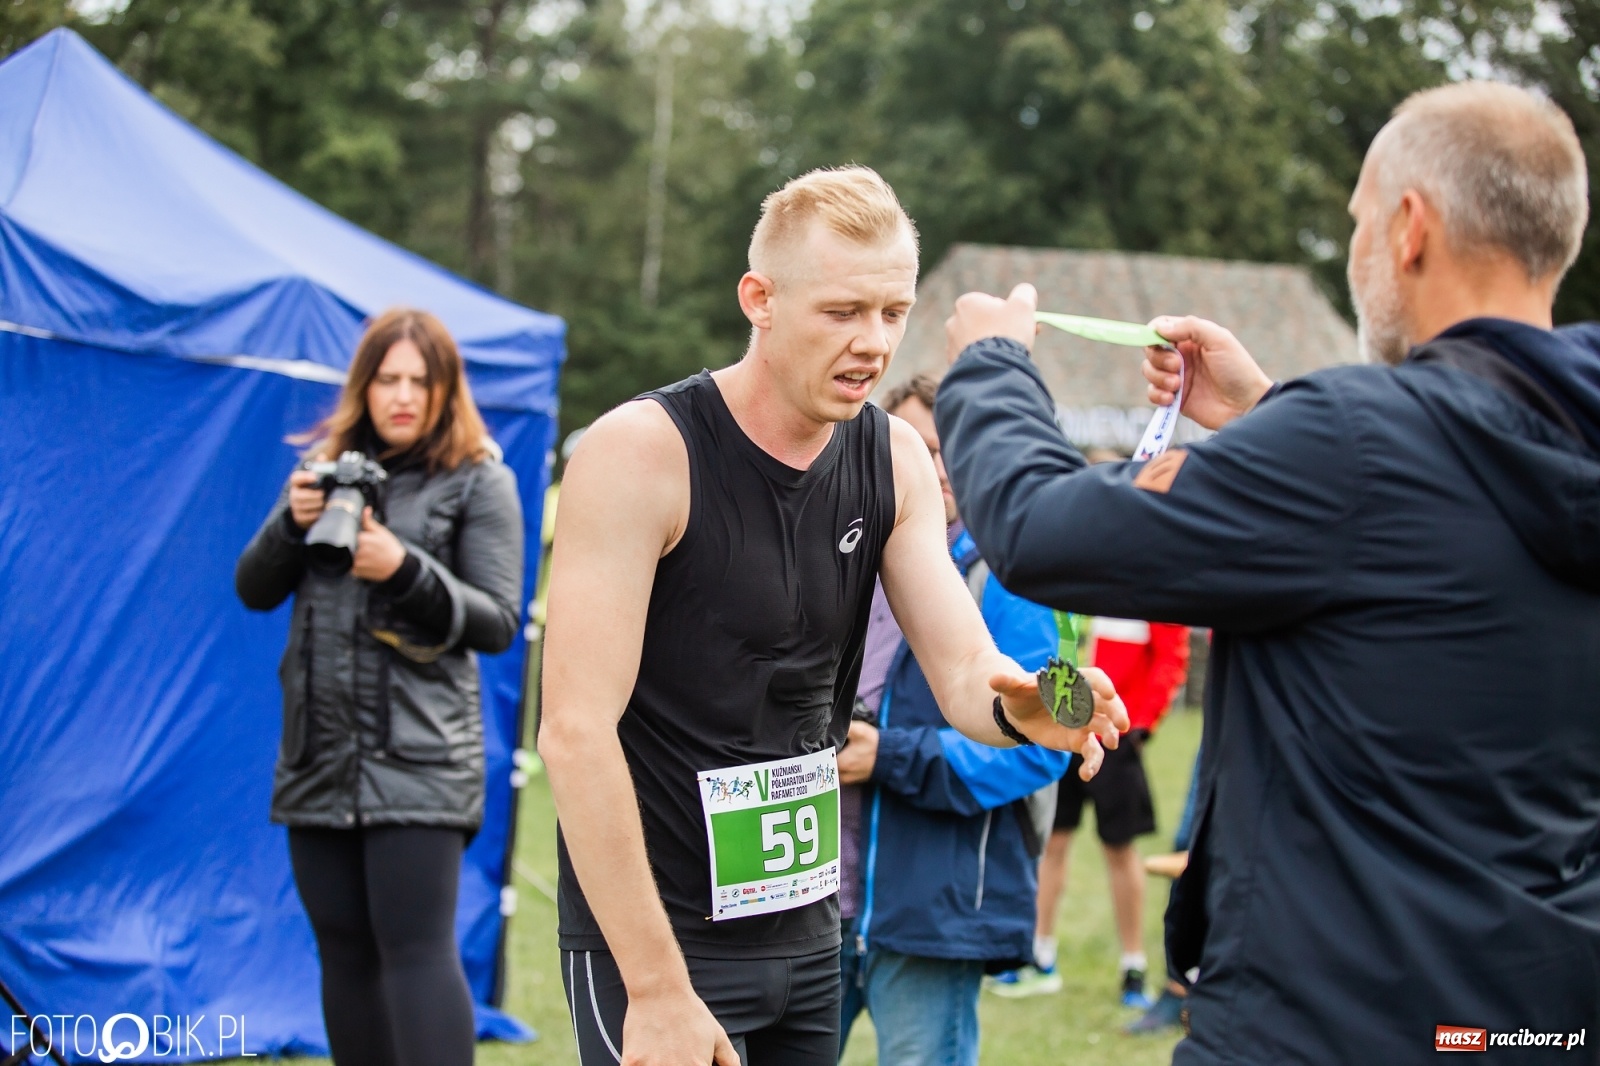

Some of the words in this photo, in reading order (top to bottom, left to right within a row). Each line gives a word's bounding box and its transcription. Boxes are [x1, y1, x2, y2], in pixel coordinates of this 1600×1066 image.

[771, 763, 803, 778] KUŹNIAŃSKI
[753, 768, 769, 802] V
[771, 774, 805, 789] PÓŁMARATON
[804, 771, 817, 783] LEŚNY
[770, 787, 796, 801] RAFAMET
[796, 784, 808, 796] 2020
[760, 803, 819, 873] 59
